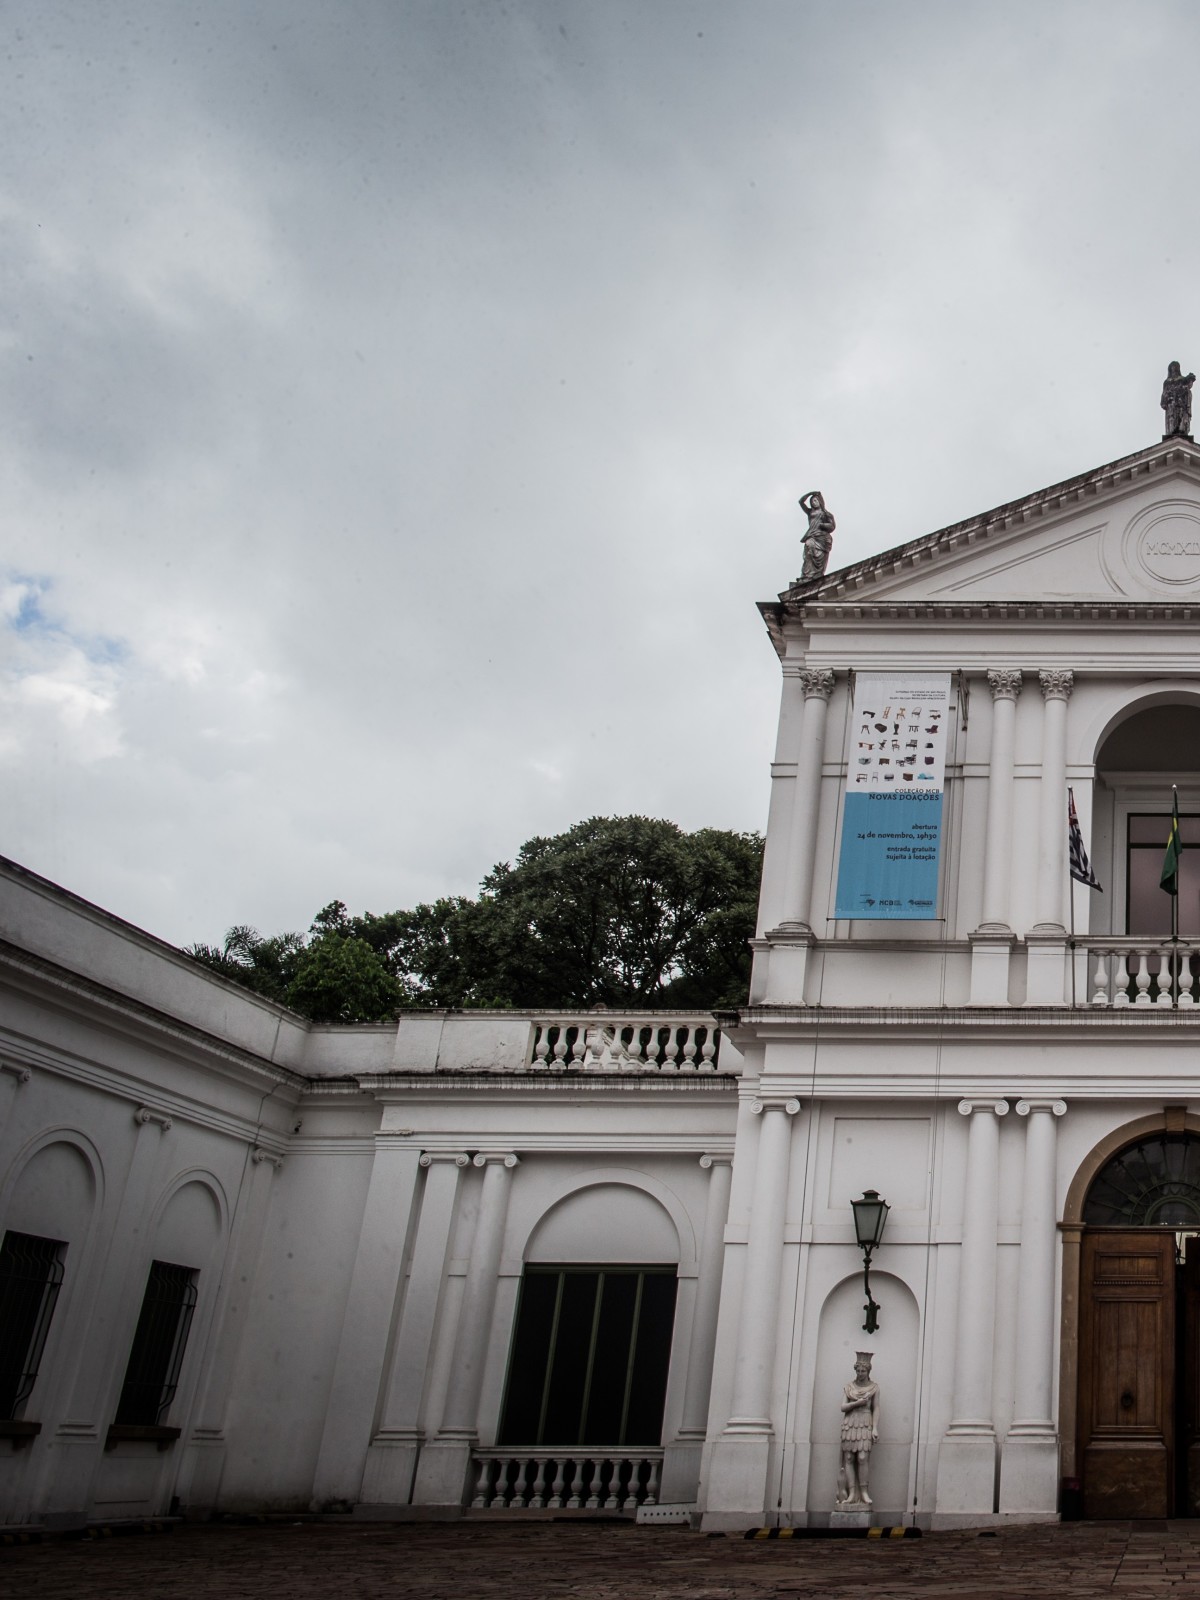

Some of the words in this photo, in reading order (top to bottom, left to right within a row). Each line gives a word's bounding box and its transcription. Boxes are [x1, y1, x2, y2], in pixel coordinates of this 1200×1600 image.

[899, 793, 940, 801] DOAÇÕES
[878, 831, 915, 839] novembro,
[917, 831, 937, 841] 19h30
